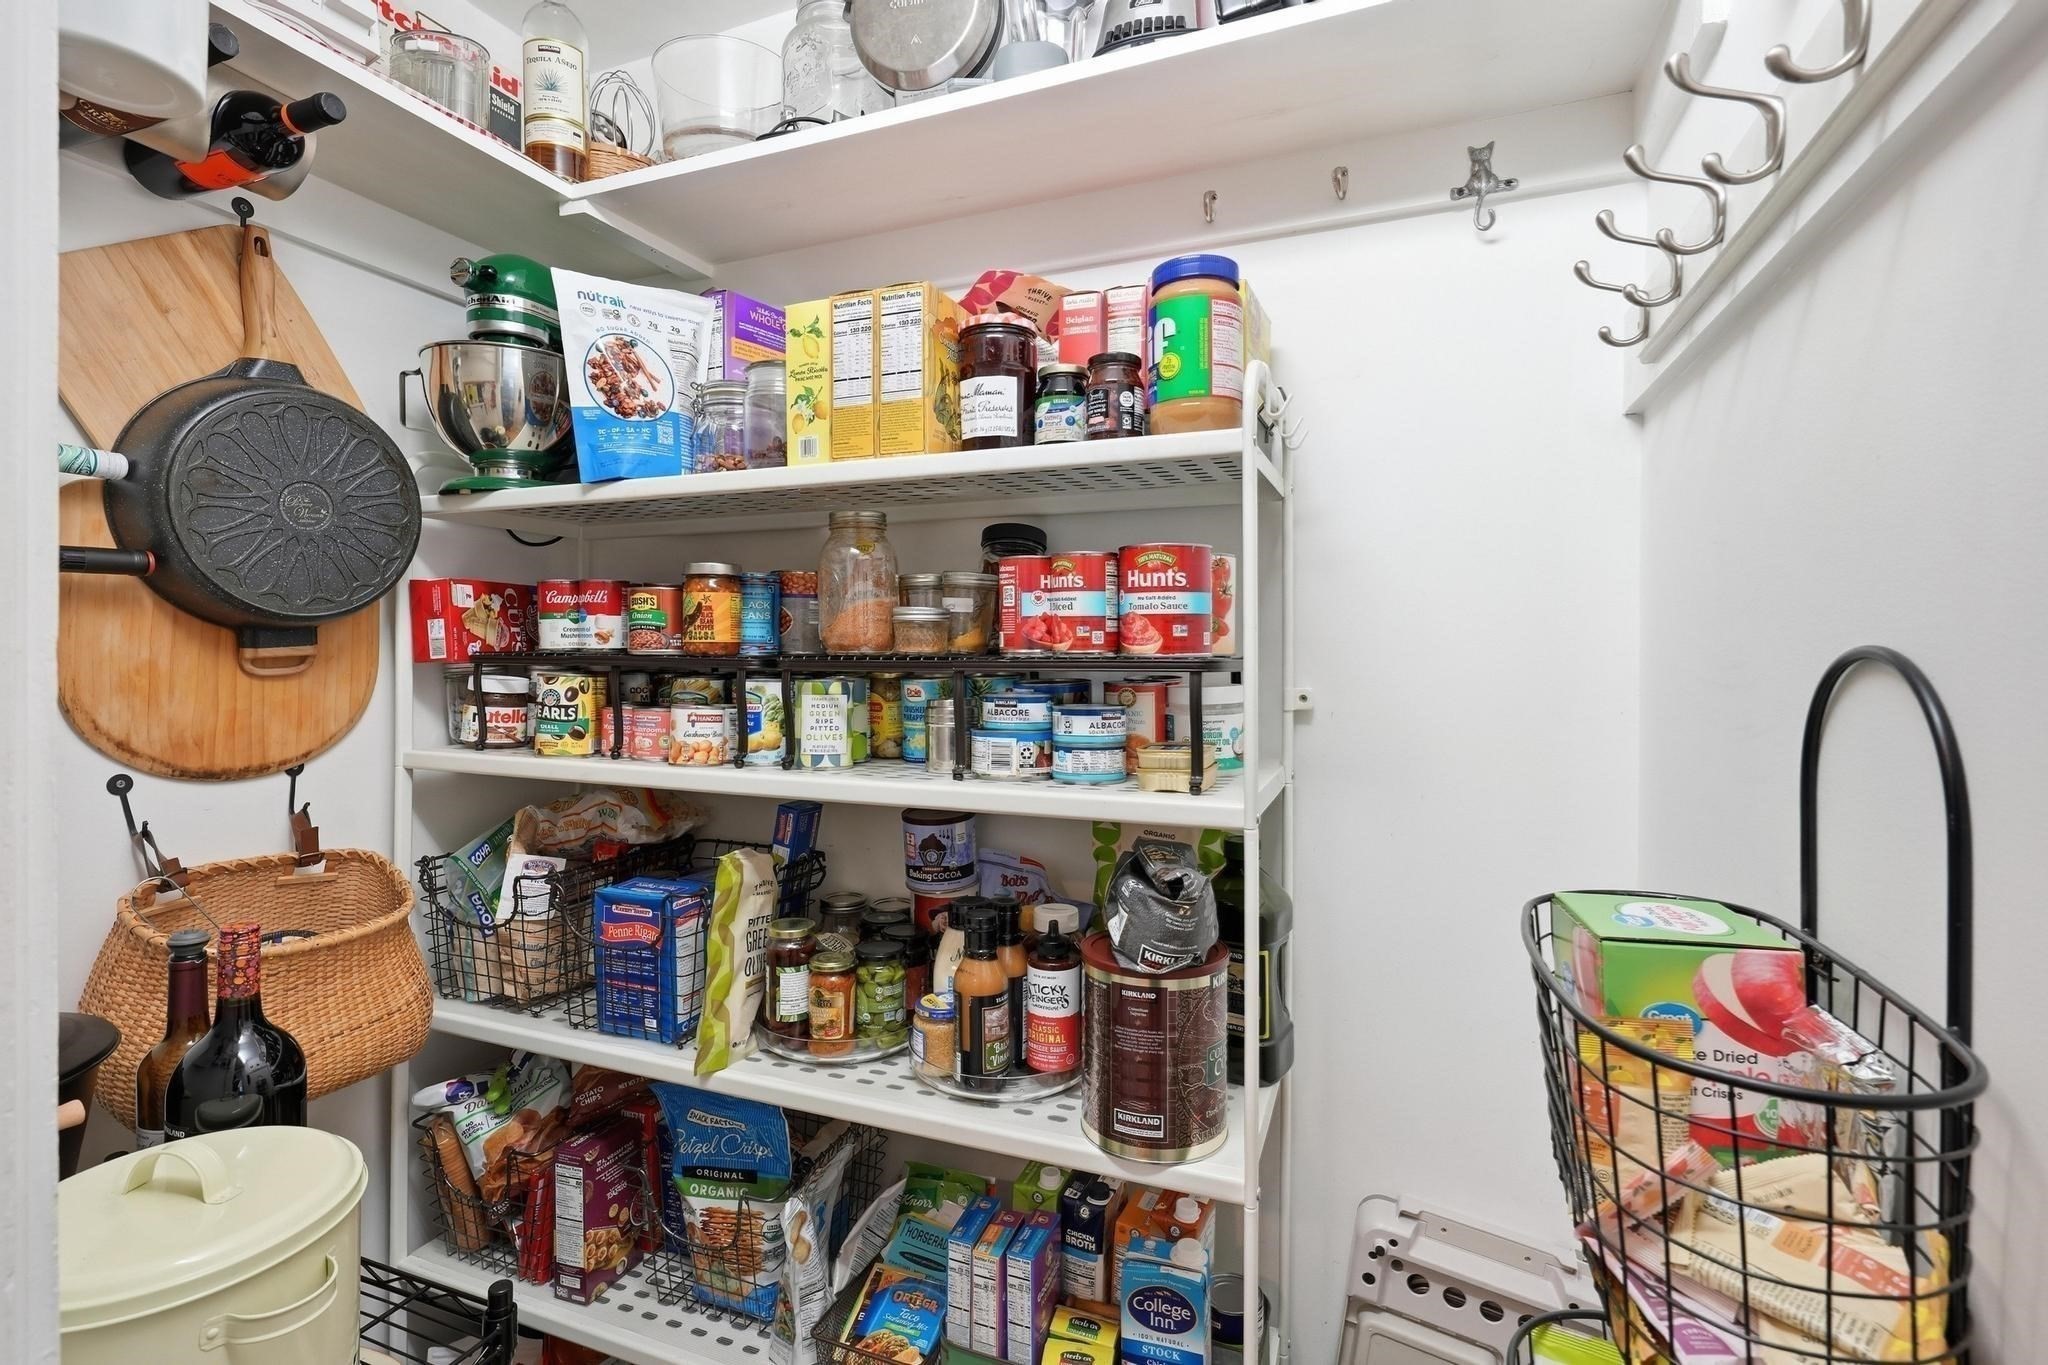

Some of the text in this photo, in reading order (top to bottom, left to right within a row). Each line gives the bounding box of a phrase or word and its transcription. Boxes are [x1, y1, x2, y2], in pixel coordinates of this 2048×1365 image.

[526, 56, 552, 65] TEQUILA
[491, 92, 515, 116] Shield
[881, 294, 905, 302] Nutrition
[1027, 287, 1053, 302] THRIVE
[833, 302, 856, 310] Nutrition
[1015, 305, 1040, 317] ORGANIC
[749, 310, 779, 329] WHOLE
[1065, 315, 1094, 325] Belgian
[973, 382, 1004, 397] Maman
[977, 400, 1014, 413] Preserves
[1148, 553, 1173, 563] NATURAL
[1127, 568, 1188, 588] Hunt's
[631, 596, 655, 607] BUSH'S
[741, 601, 770, 609] LACK
[1129, 601, 1189, 610] Tomato Sauce
[631, 611, 653, 620] Onion
[741, 611, 771, 620] EANS
[687, 631, 715, 640] SALSA
[906, 687, 922, 697] Dole
[986, 708, 1030, 717] ALBACORE
[1088, 721, 1126, 730] ALBACOR
[805, 733, 844, 742] OLIVES
[1143, 829, 1176, 840] ORGANIC
[471, 843, 492, 865] GOYA
[909, 869, 962, 882] Baking COCOA
[1000, 874, 1029, 887] Bob's
[754, 880, 774, 892] THRIVE
[748, 914, 773, 928] PITTE
[608, 925, 632, 938] Penne
[746, 928, 768, 953] GREE
[744, 953, 767, 977] OLIVE
[1028, 981, 1067, 1000] STICKY
[1121, 989, 1157, 1000] KIRKLAND
[1032, 993, 1070, 1010] FINGERS
[1031, 1022, 1060, 1034] CLASSIC
[1028, 1028, 1066, 1044] ORIGINAL
[1050, 1045, 1067, 1053] SAUCE
[1713, 1049, 1758, 1065] Dried
[575, 1085, 604, 1103] POTATO
[580, 1093, 602, 1106] CHIPS
[1117, 1111, 1161, 1127] KIRKLAND
[461, 1121, 485, 1137] ARTIFICIAL
[720, 1133, 773, 1163] Crisps
[696, 1168, 745, 1180] ORIGINAL
[689, 1183, 749, 1198] ORGANIC
[901, 1194, 934, 1209] Knorr
[904, 1225, 949, 1251] HORSERAD
[1066, 1228, 1095, 1242] CHICKEN
[1065, 1234, 1096, 1251] BROTH
[893, 1290, 939, 1314] ORTEGA
[1132, 1296, 1191, 1321] College
[899, 1307, 921, 1322] Taco
[1156, 1336, 1184, 1348] NATURAL
[1141, 1344, 1181, 1361] STOCK
